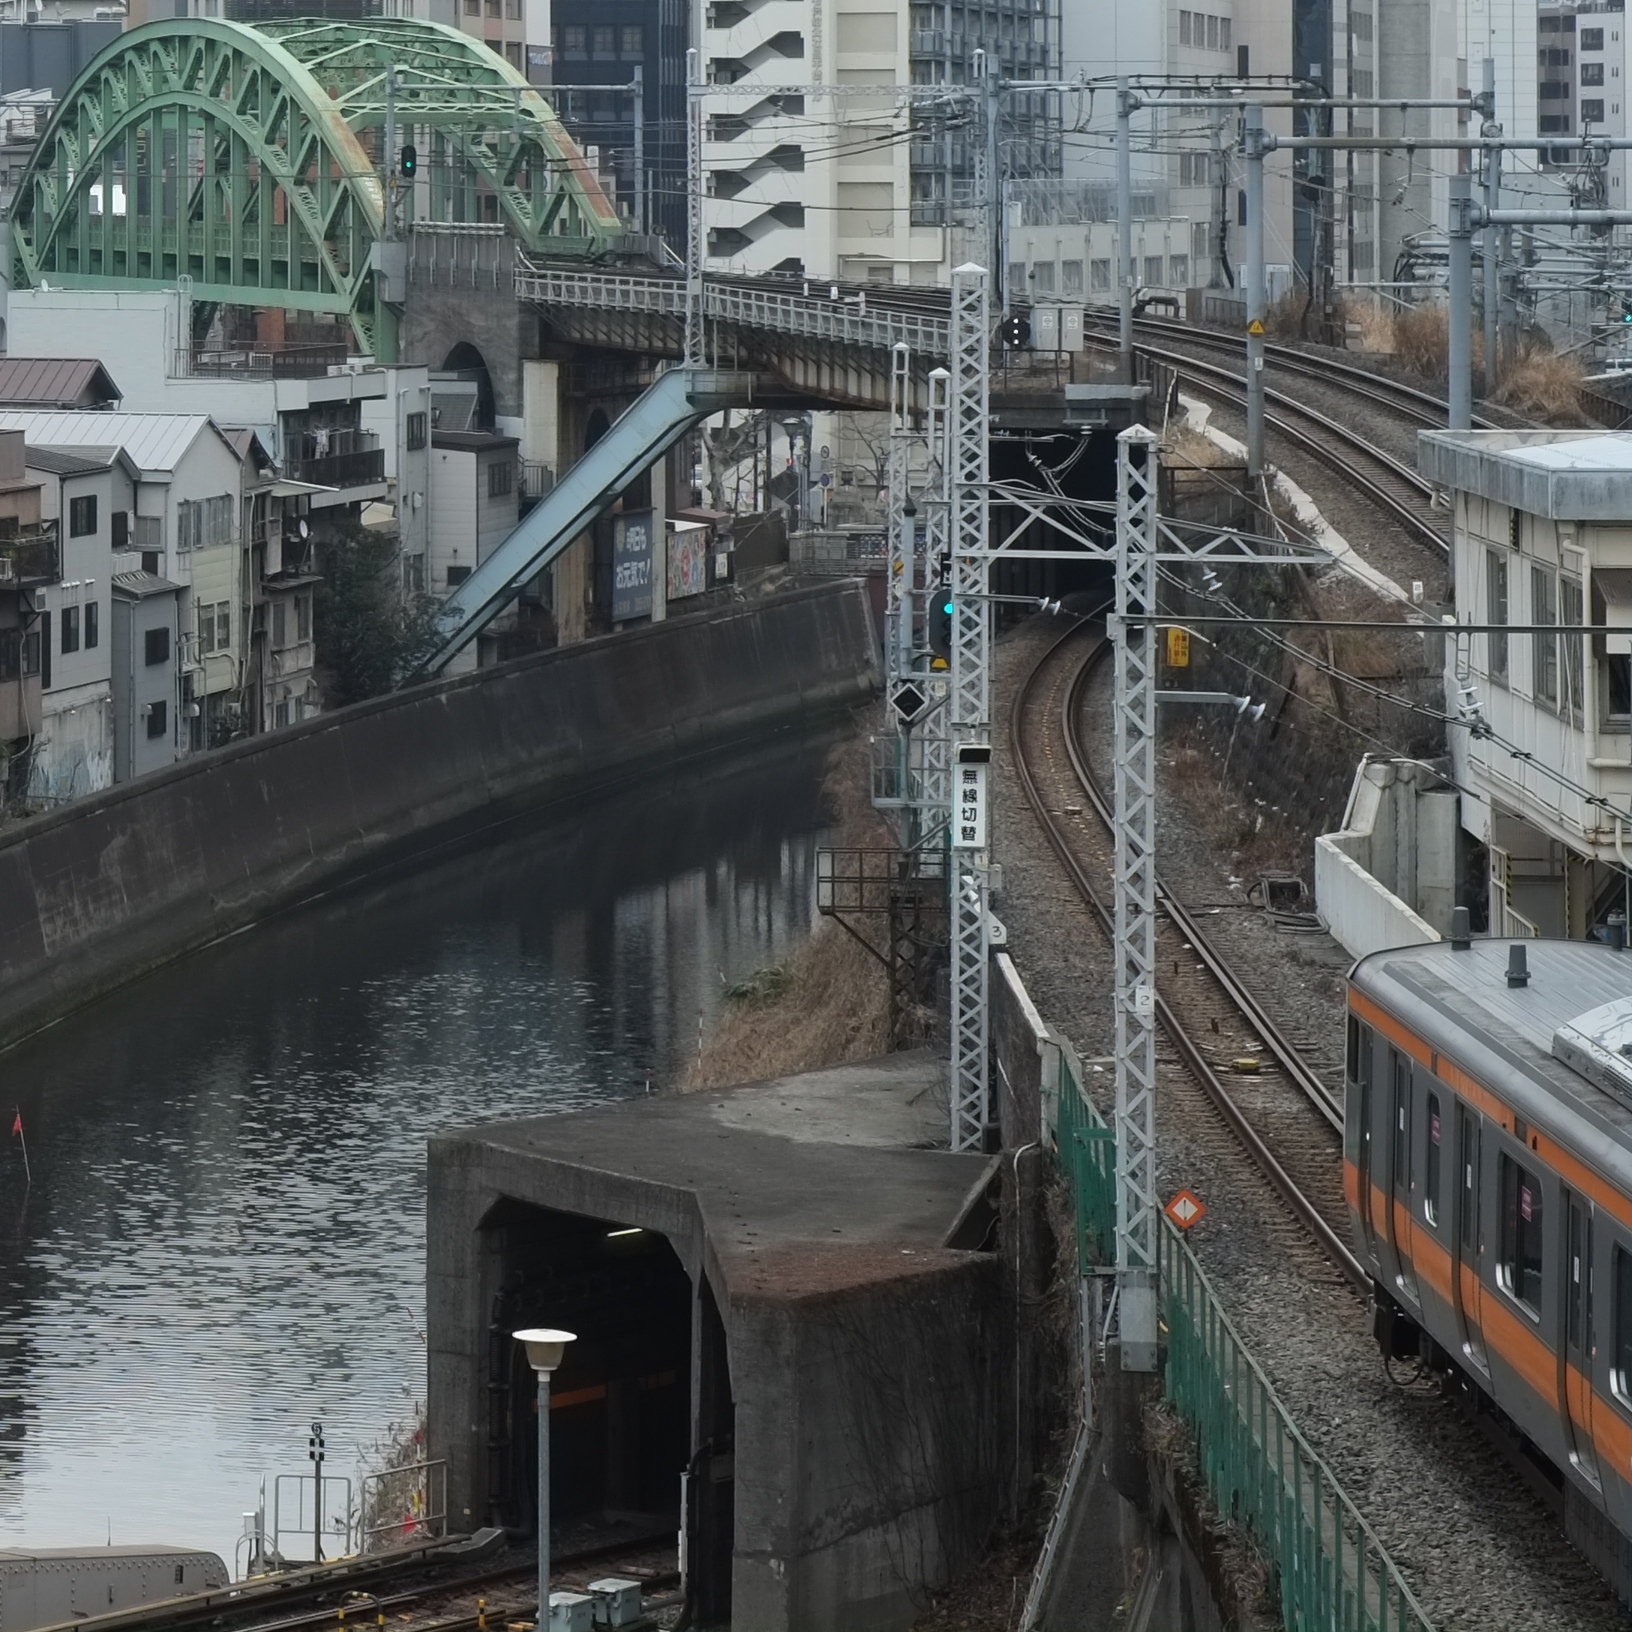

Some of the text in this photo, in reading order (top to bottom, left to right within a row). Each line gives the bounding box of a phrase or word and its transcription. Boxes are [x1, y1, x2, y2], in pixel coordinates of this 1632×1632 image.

[960, 769, 978, 842] 無線切替
[992, 926, 1003, 938] 3
[1140, 995, 1151, 1006] 2
